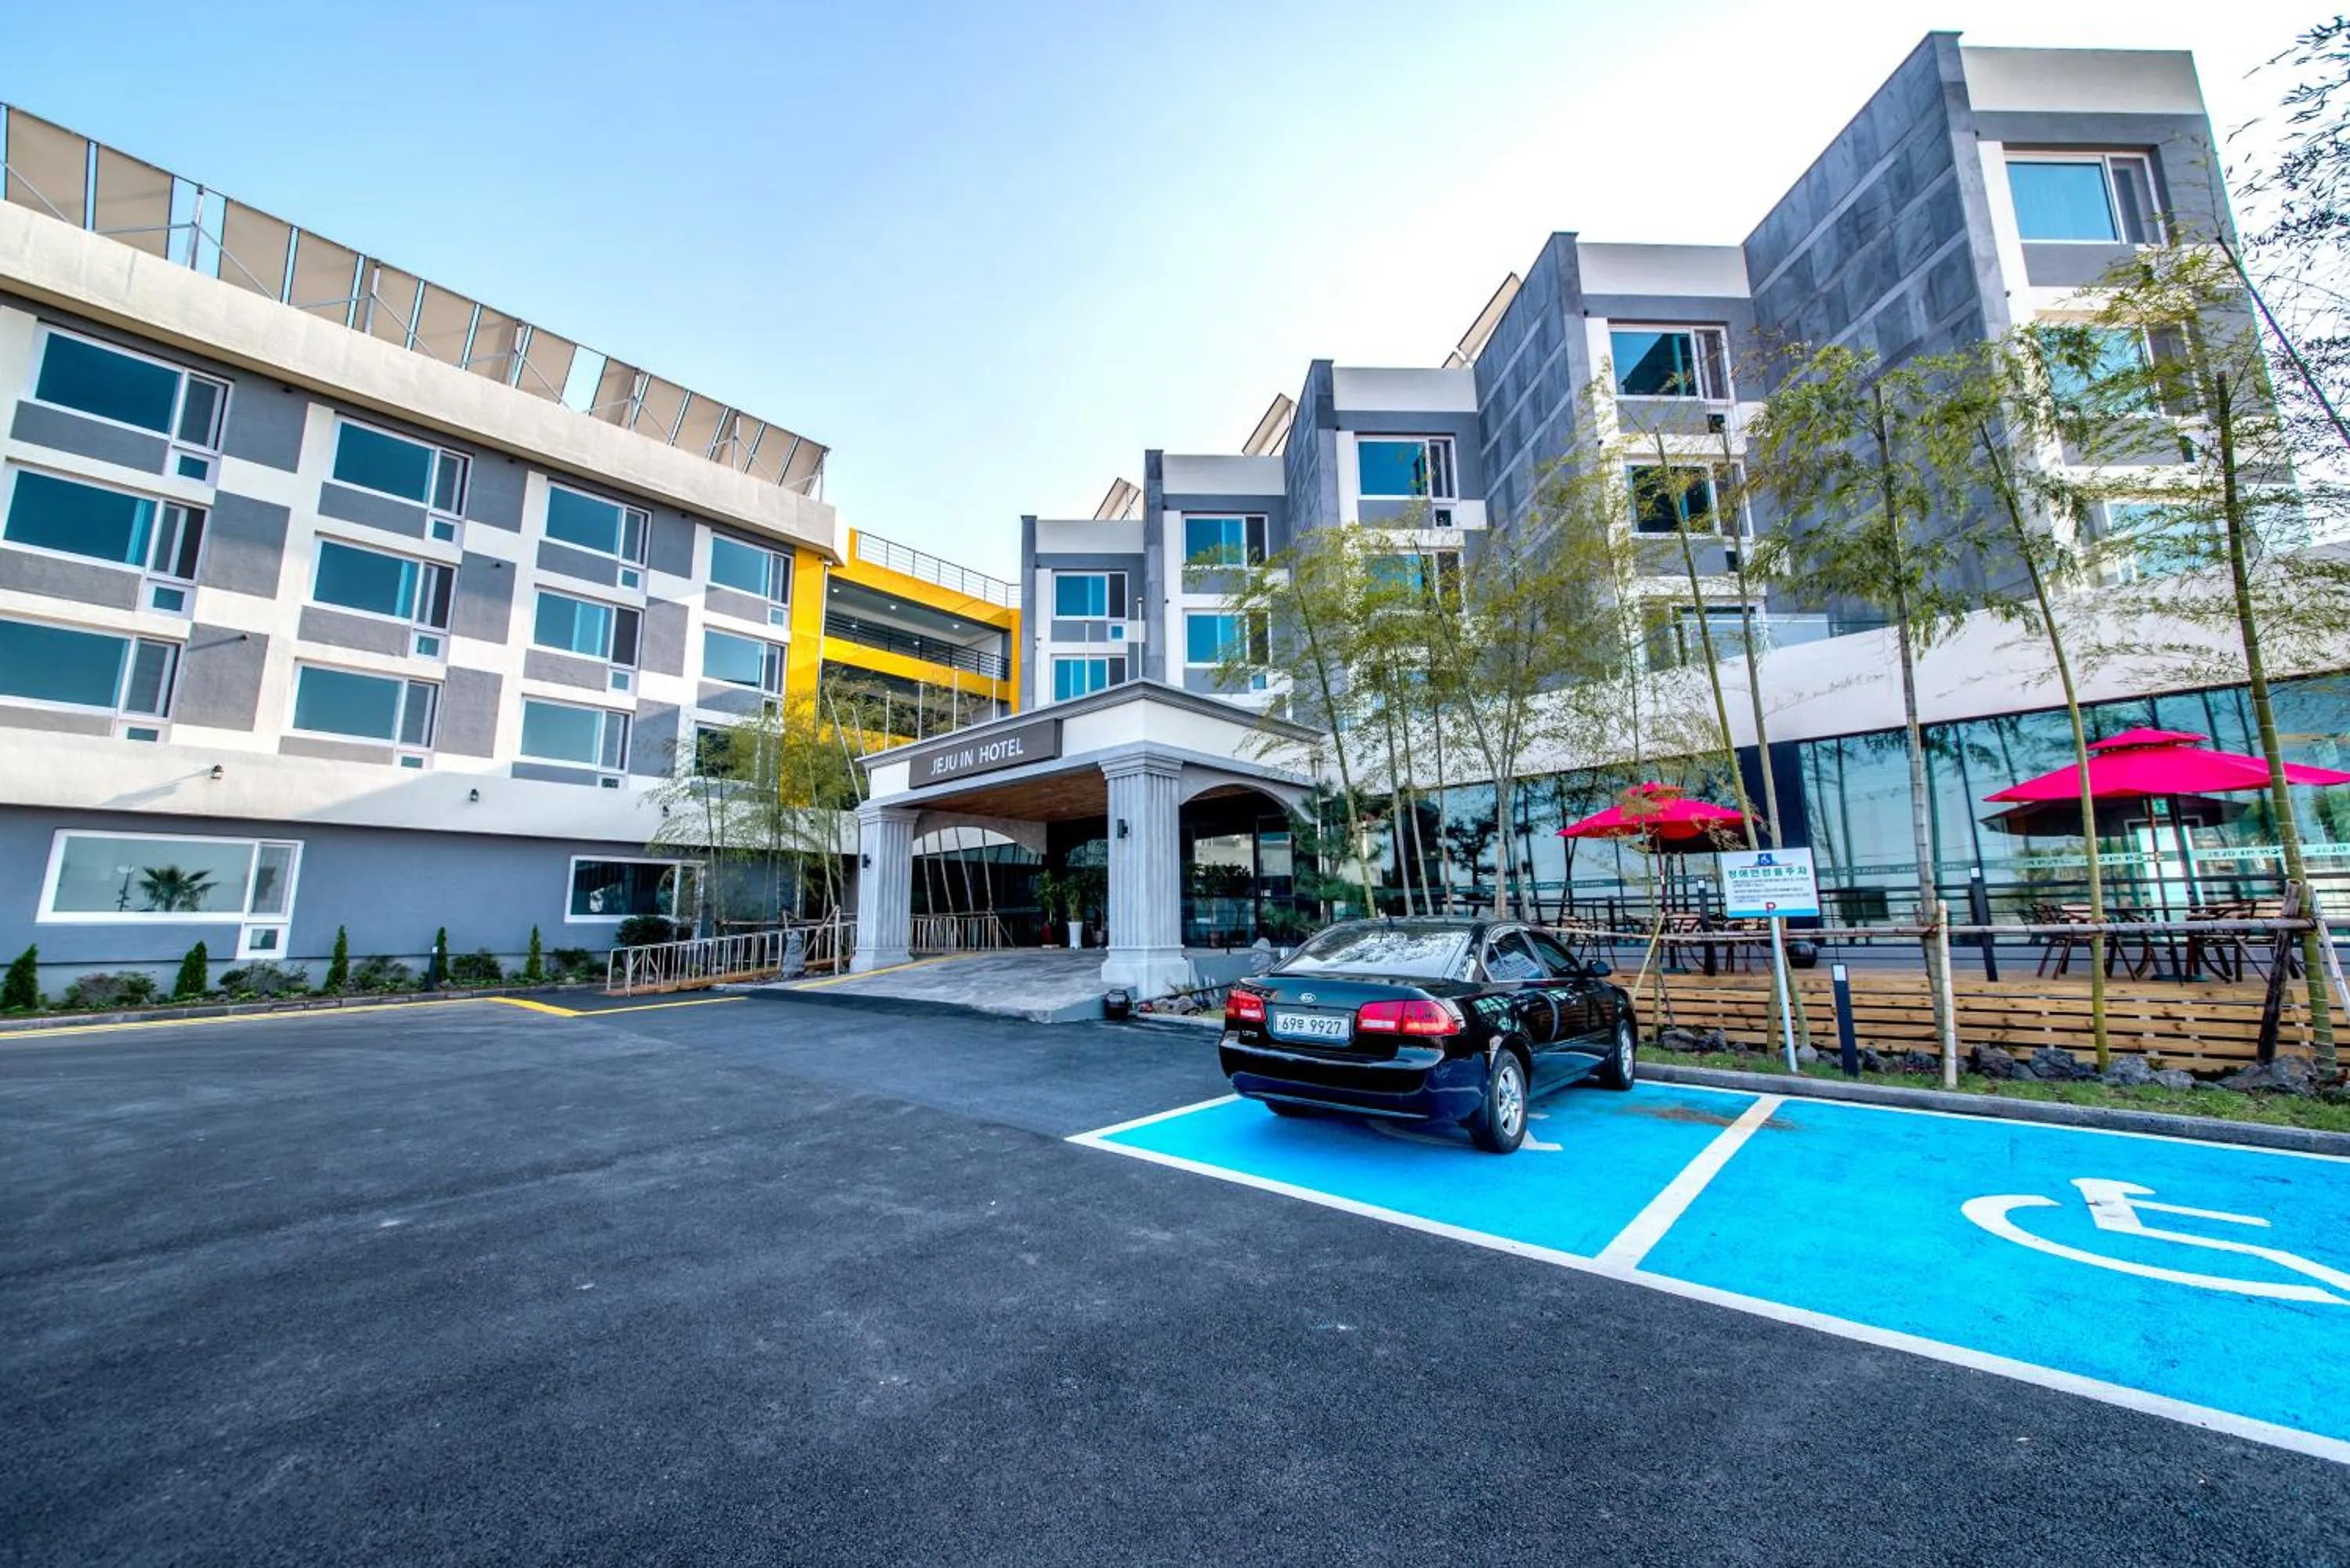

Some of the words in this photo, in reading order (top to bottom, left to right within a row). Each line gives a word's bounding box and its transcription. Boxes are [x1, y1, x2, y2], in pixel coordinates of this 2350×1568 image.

[931, 754, 957, 775] JEJU
[960, 749, 974, 768] IN
[978, 737, 1024, 764] HOTEL
[1310, 1018, 1342, 1035] 9927
